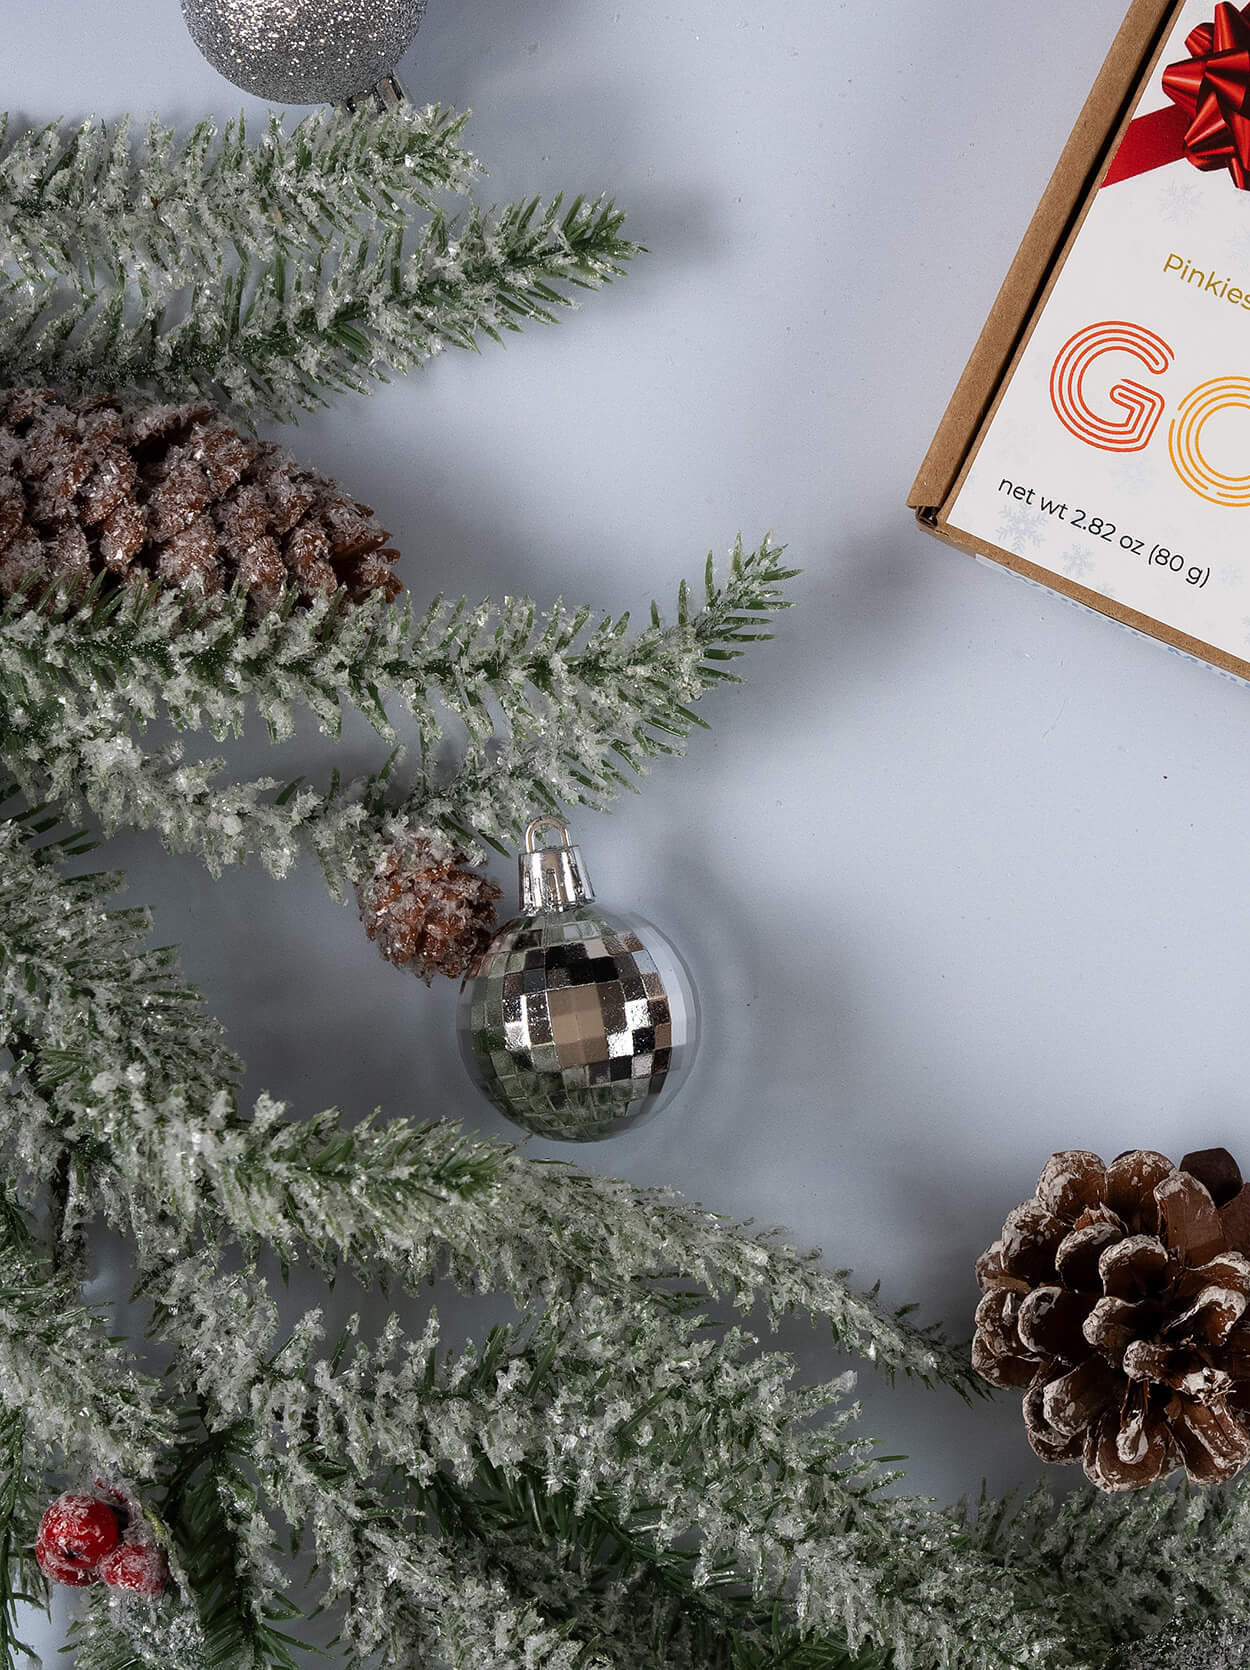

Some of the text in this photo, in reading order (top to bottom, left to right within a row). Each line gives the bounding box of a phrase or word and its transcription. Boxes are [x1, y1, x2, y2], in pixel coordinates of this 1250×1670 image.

[998, 478, 1210, 589] net wt 2.82 oz (80 g)
